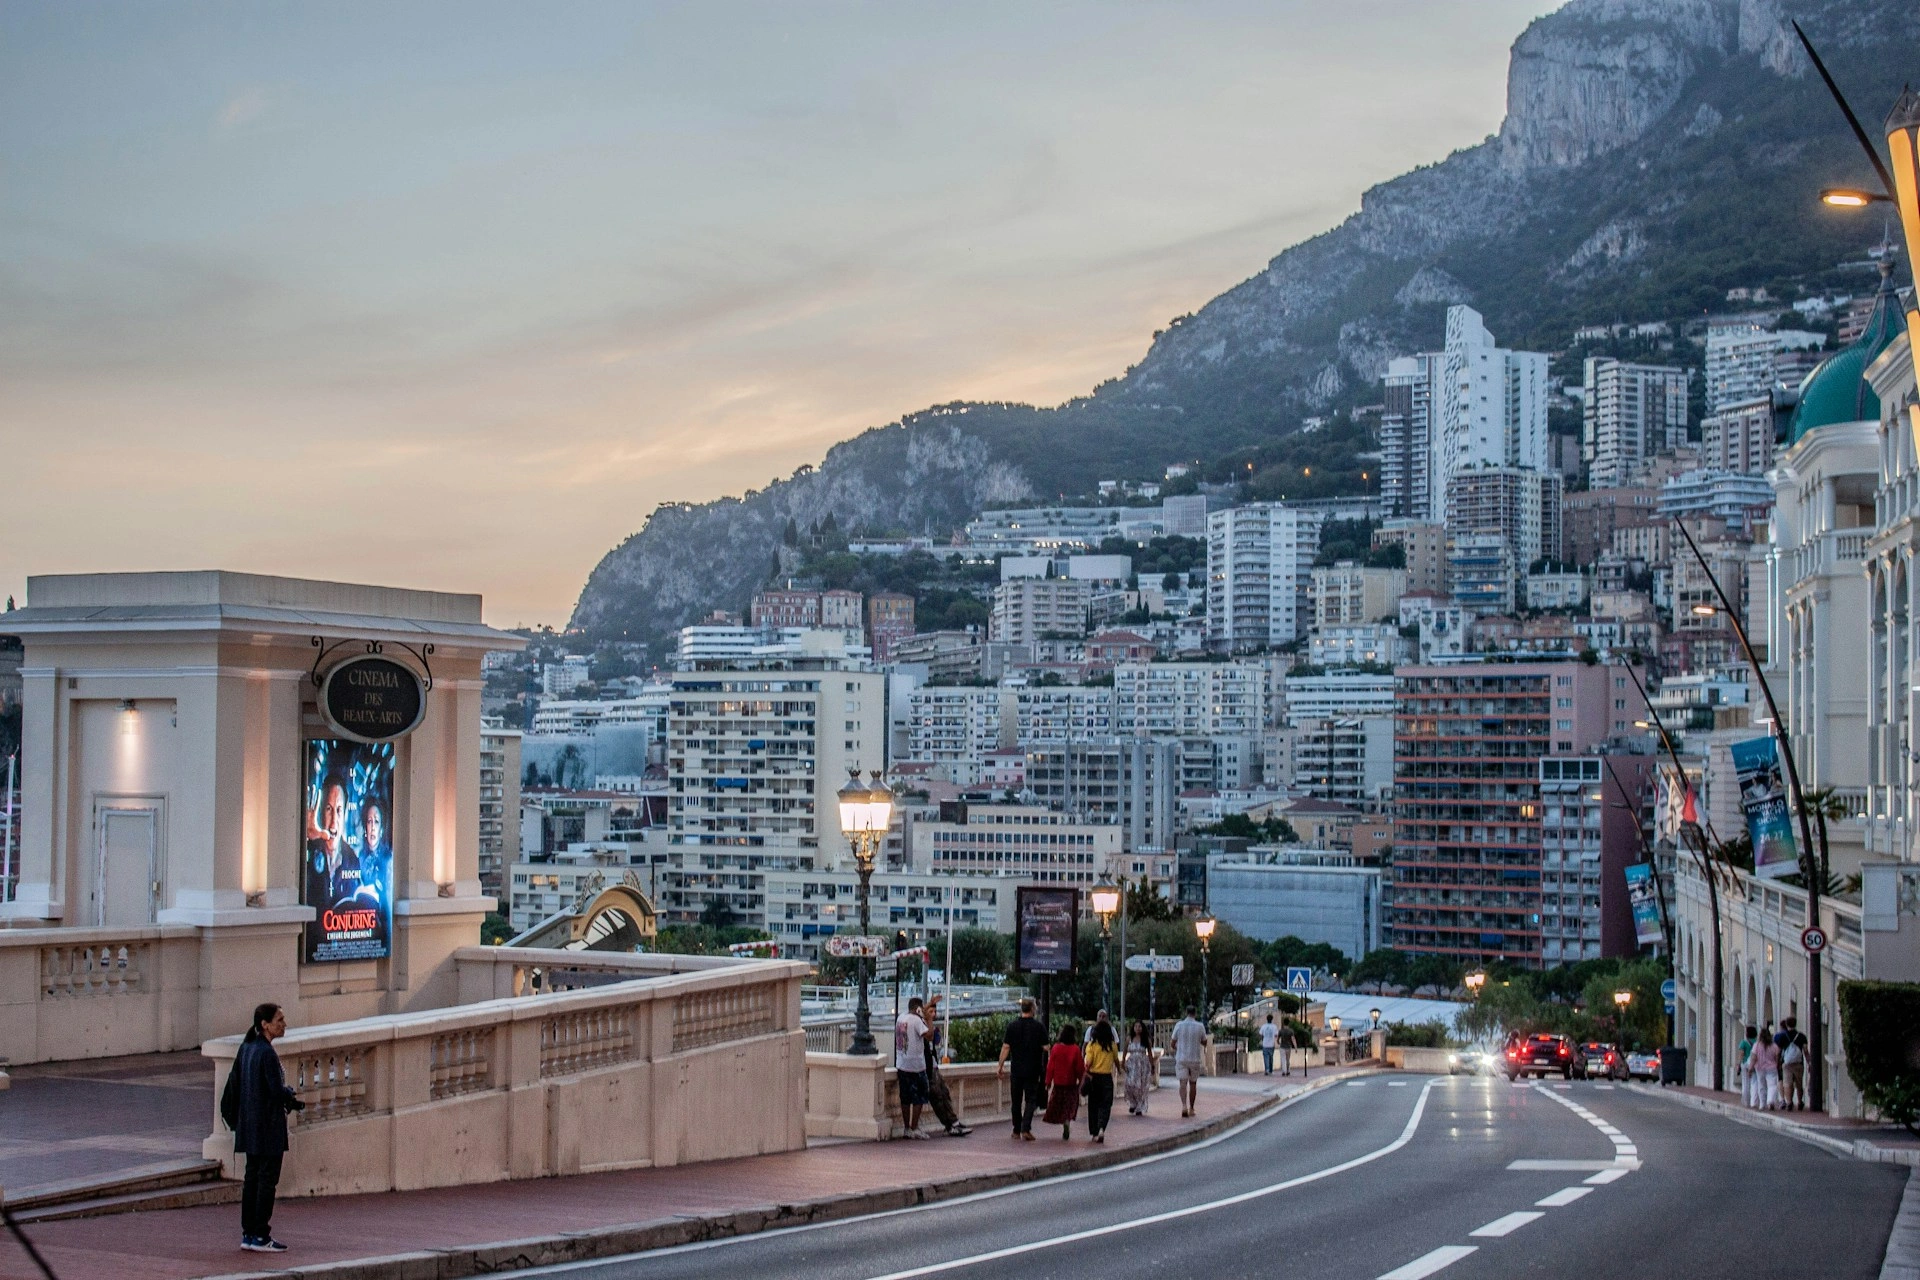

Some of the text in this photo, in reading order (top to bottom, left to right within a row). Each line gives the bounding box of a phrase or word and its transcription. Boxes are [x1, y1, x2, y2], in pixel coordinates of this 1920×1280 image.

[348, 669, 399, 688] CINEMA
[364, 692, 383, 706] DES
[1747, 799, 1784, 814] MONACO
[1761, 805, 1785, 817] YACHT
[1756, 816, 1778, 826] SHOW
[323, 910, 376, 932] CONJURING
[1807, 934, 1822, 945] 50
